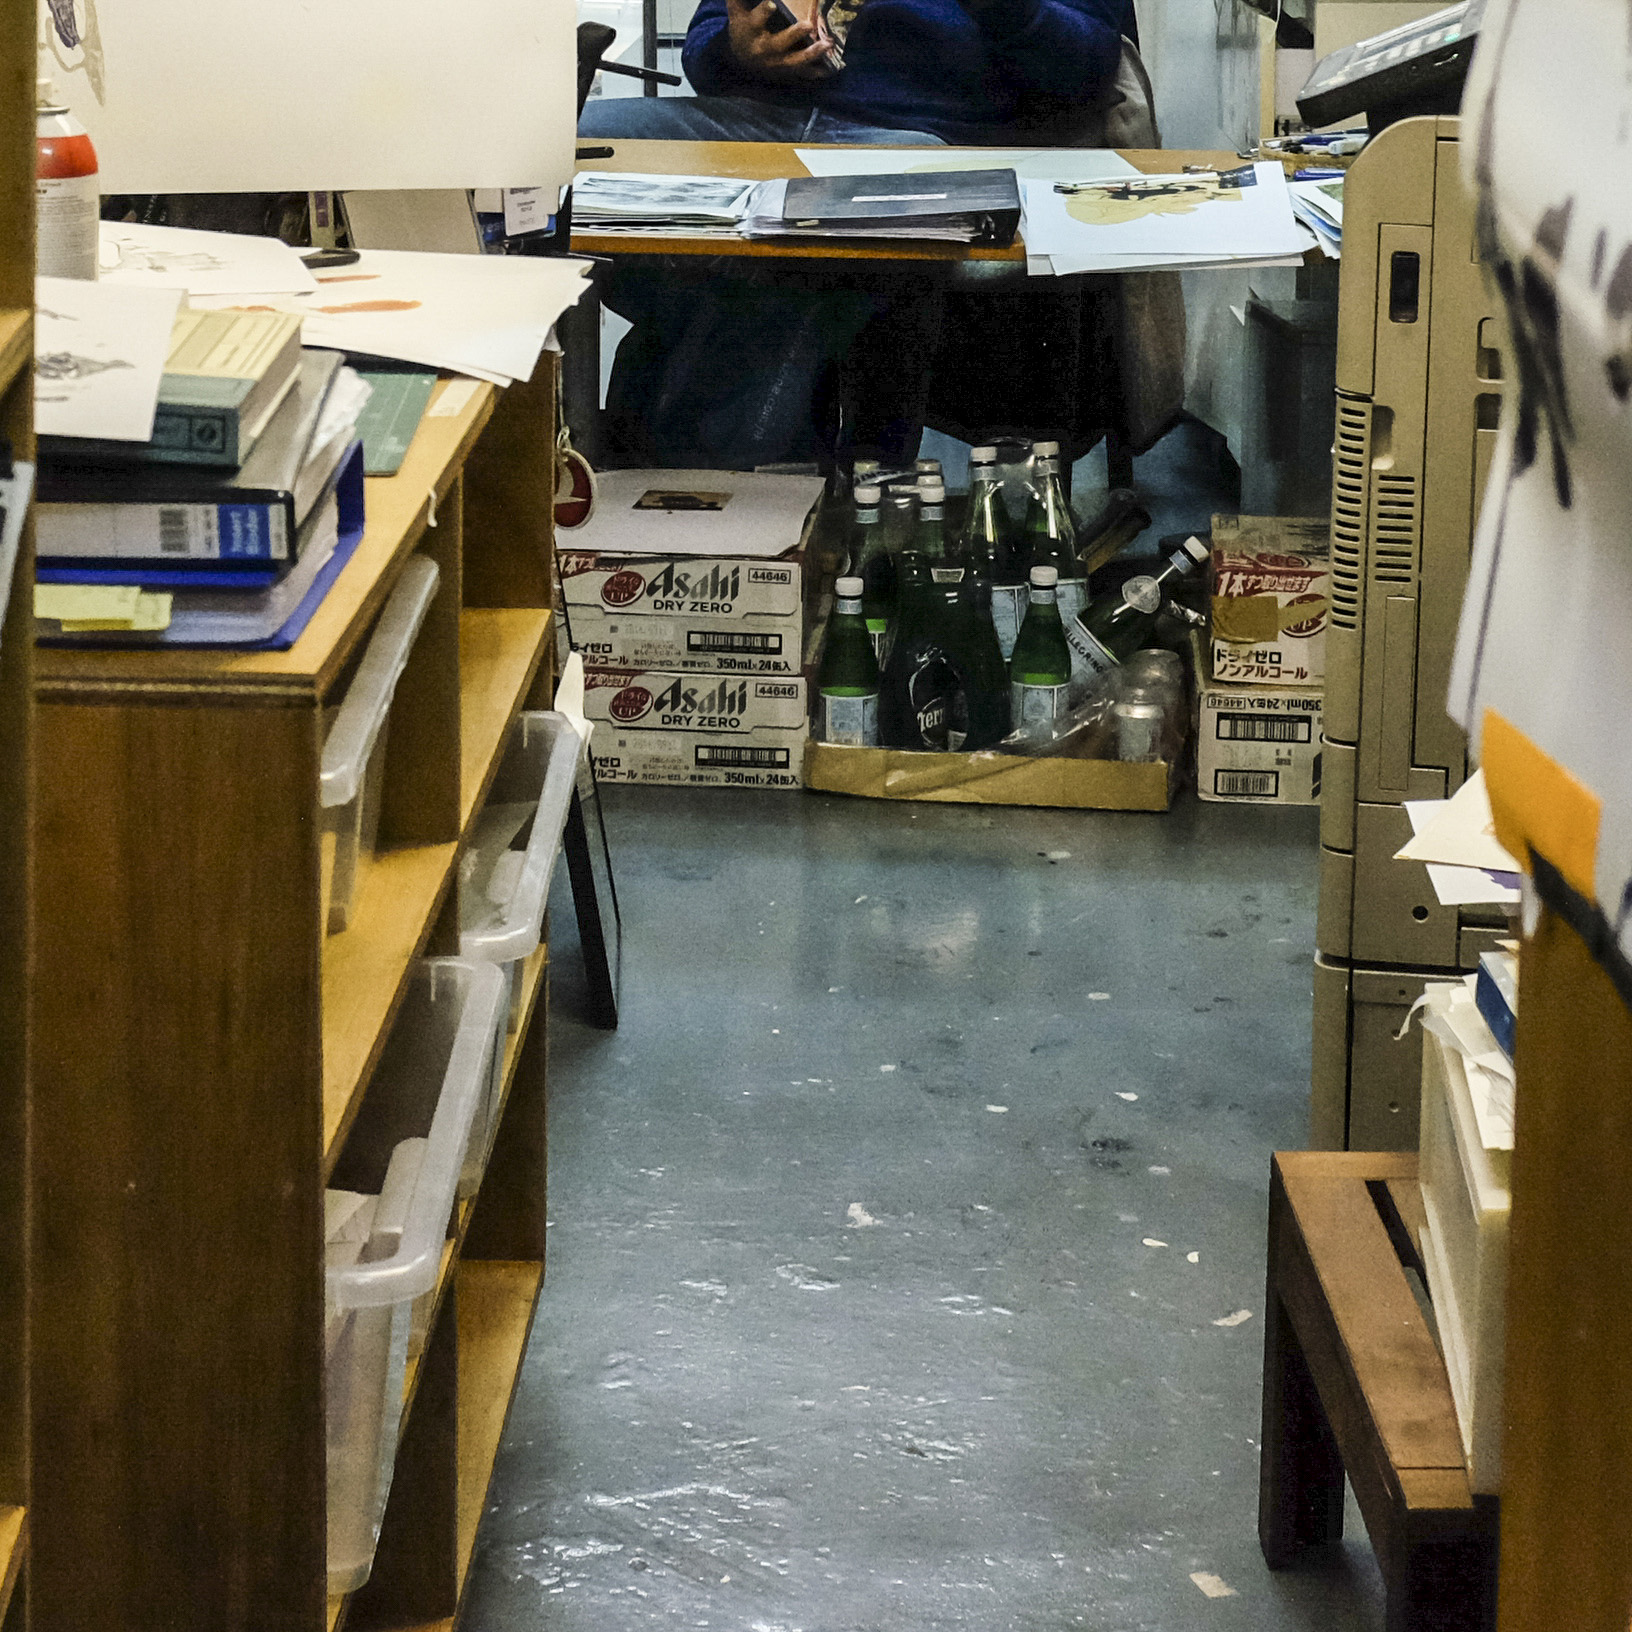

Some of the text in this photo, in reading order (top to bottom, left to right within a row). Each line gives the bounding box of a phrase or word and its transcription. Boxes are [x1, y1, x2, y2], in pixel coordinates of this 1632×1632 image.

[645, 562, 741, 602] Asahi
[653, 599, 734, 614] DRY ZERO
[1216, 663, 1309, 680] ノンアルコール
[653, 677, 748, 716] Asahi
[661, 714, 741, 729] DRY ZERO
